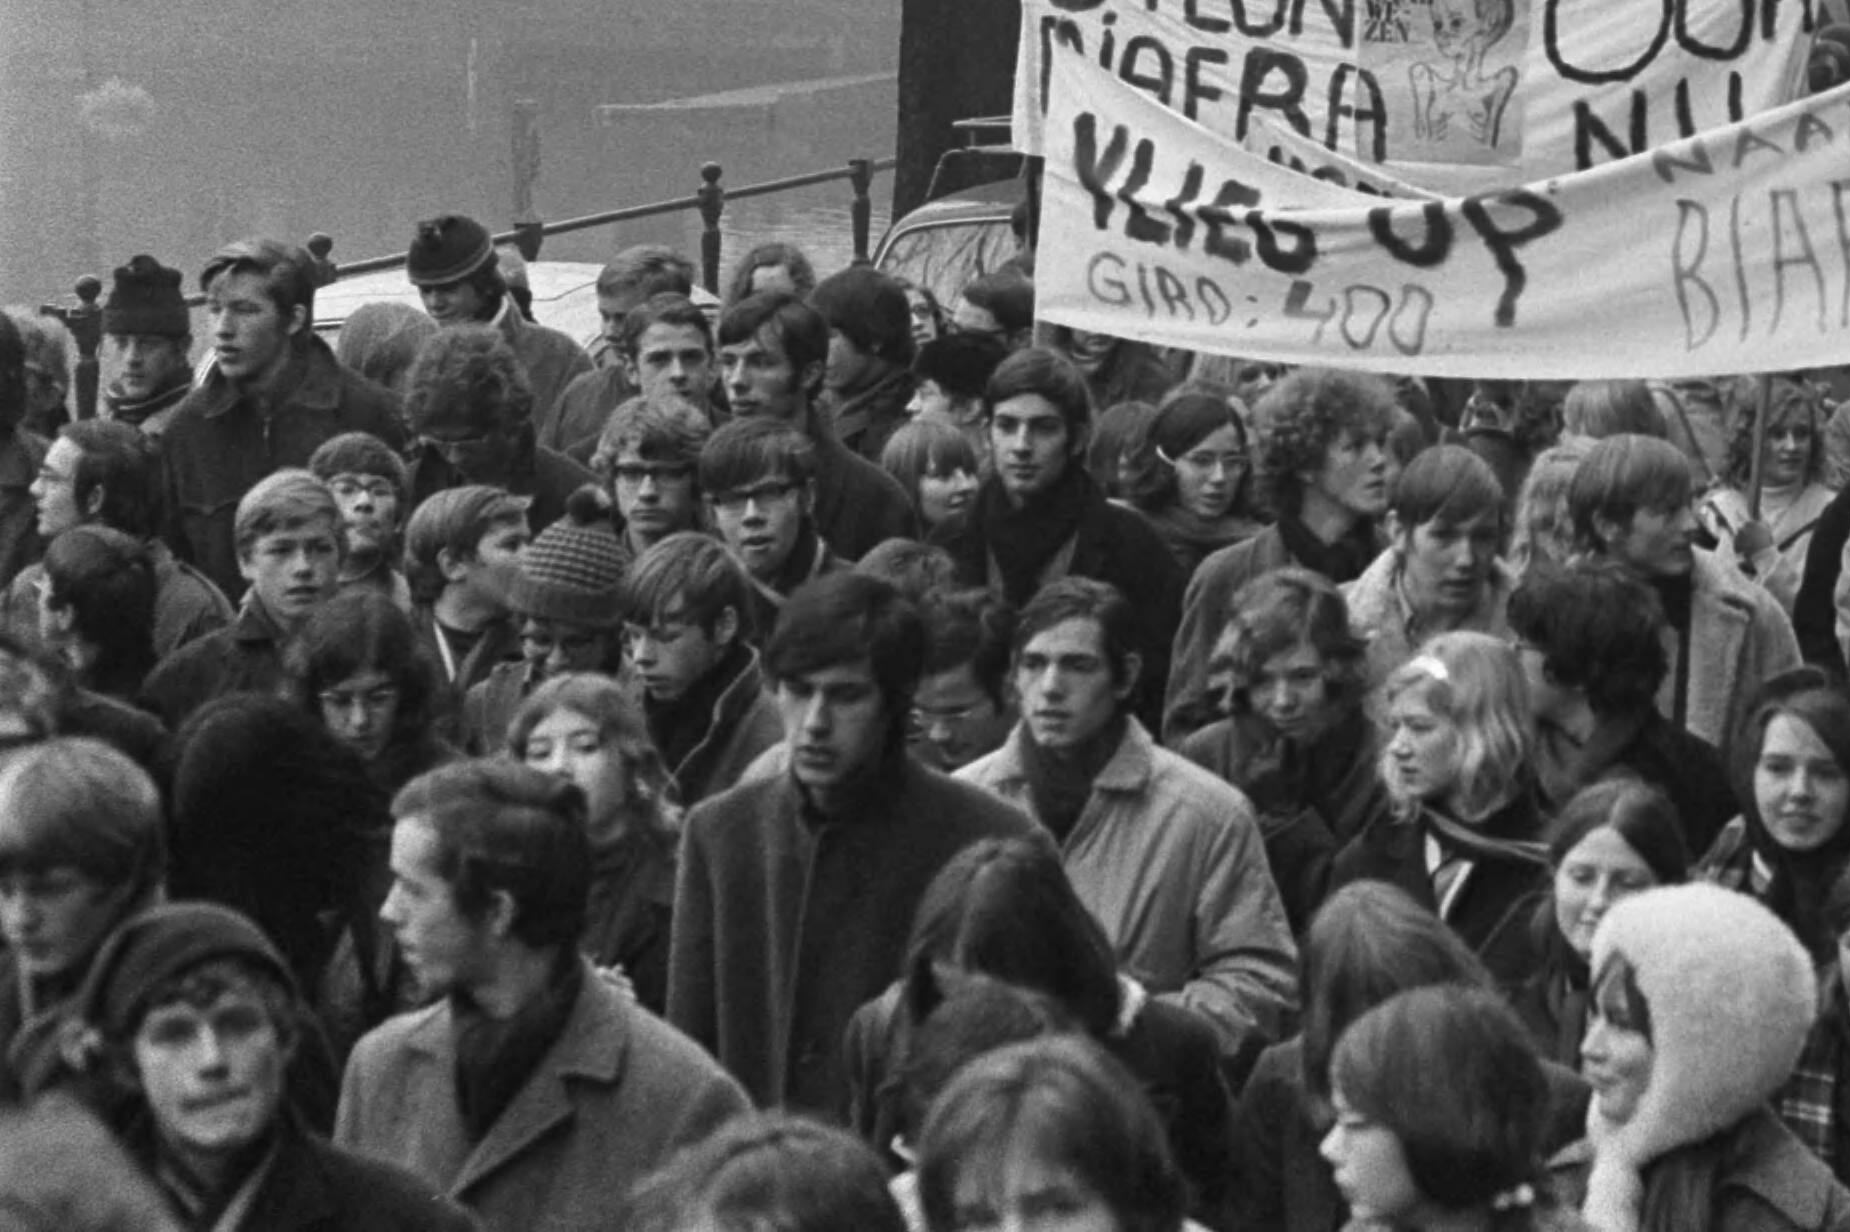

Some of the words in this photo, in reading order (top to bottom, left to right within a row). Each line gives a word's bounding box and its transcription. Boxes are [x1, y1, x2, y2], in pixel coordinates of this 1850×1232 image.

[1574, 71, 1743, 171] NU
[1074, 111, 1318, 274] VLIEG
[1283, 280, 1433, 356] 400
